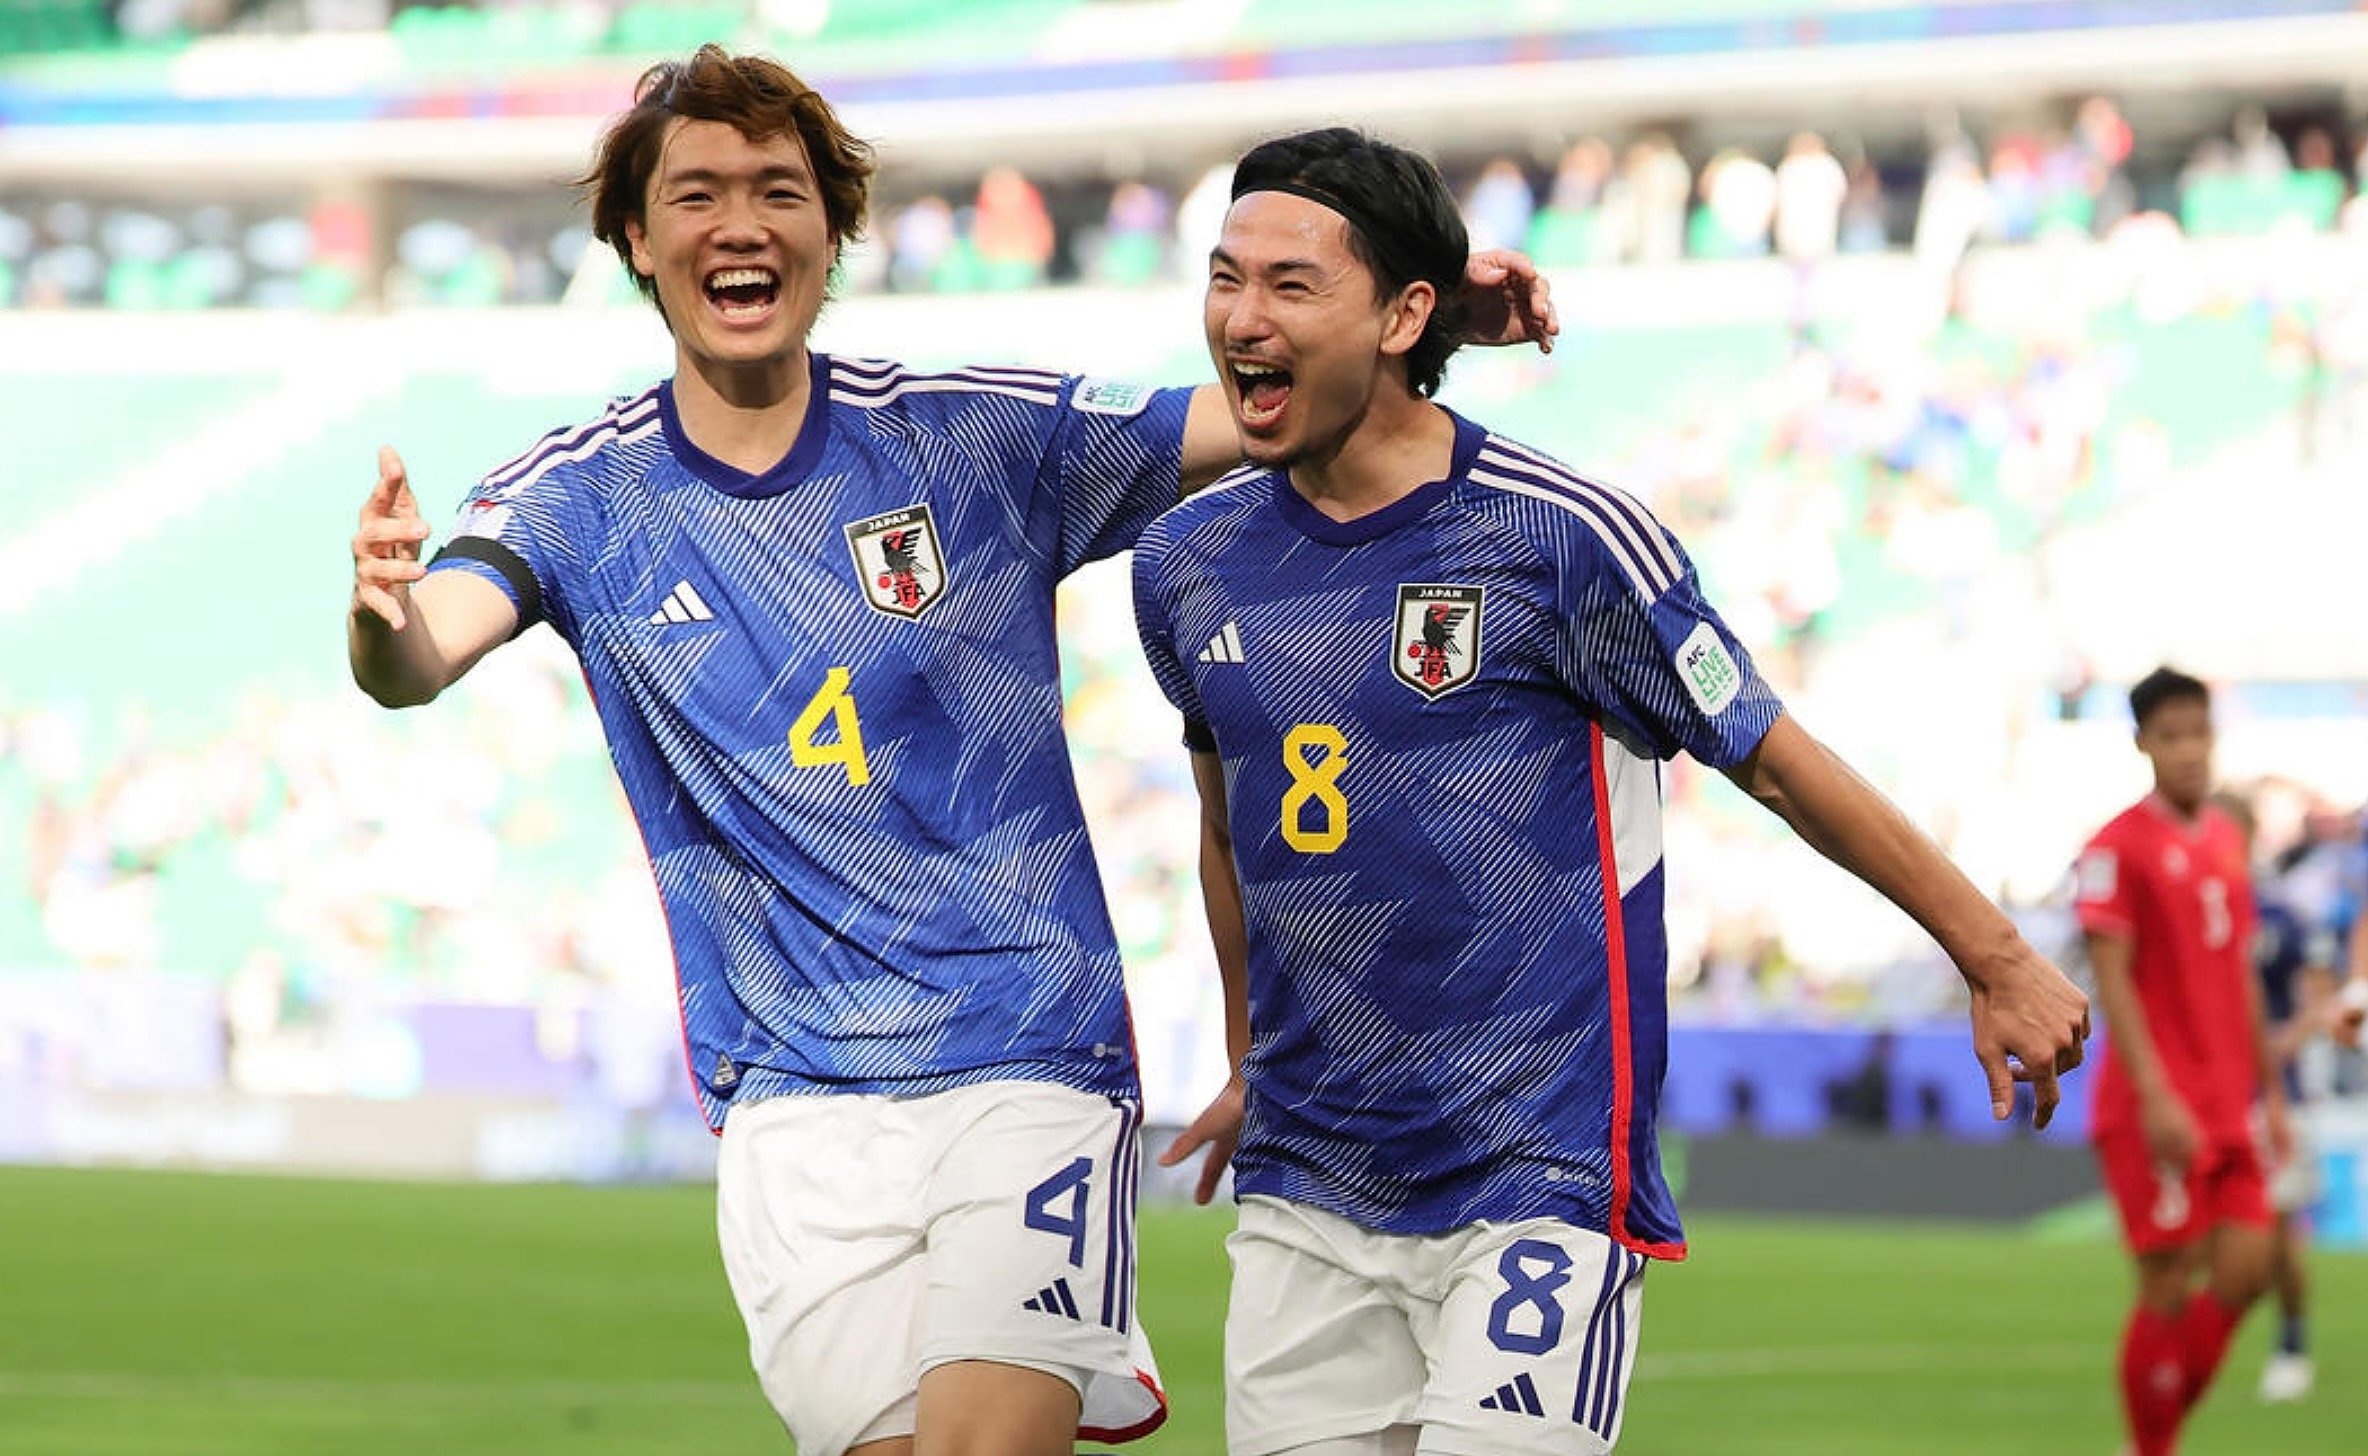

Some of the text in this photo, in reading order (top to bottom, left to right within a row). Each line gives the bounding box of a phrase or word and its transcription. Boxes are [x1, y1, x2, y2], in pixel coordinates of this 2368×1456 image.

[868, 513, 911, 532] JAPAN
[892, 582, 926, 604] JFA
[1419, 588, 1463, 598] JAPAN
[1687, 644, 1706, 668] AFC
[1414, 660, 1453, 678] JFA
[789, 668, 869, 787] 4
[1282, 723, 1348, 853] 8
[1024, 1158, 1093, 1267] 4
[1487, 1239, 1573, 1355] 8
